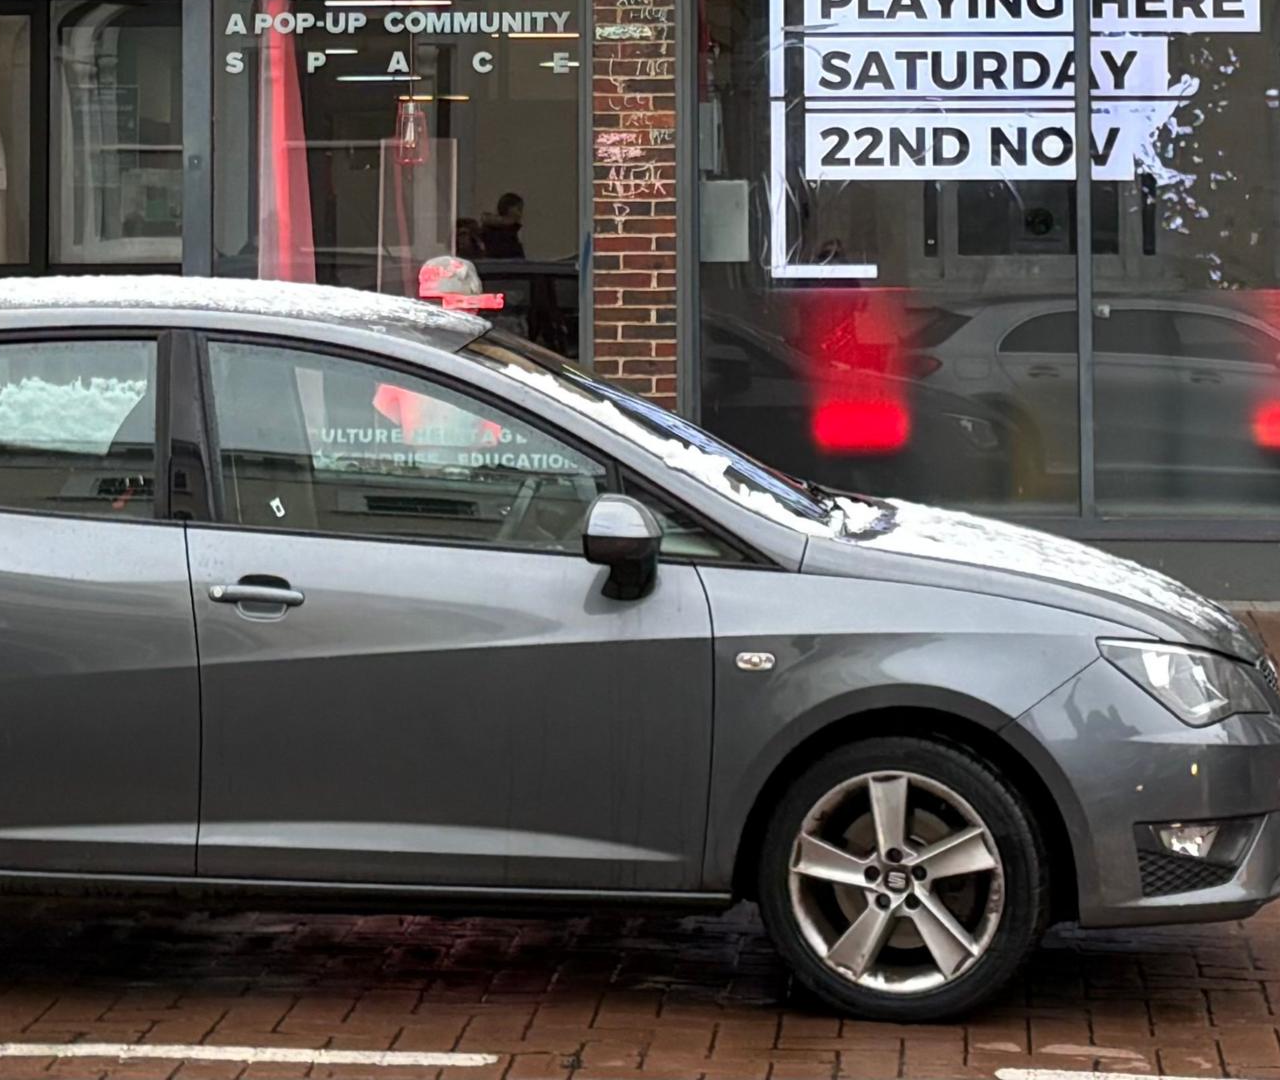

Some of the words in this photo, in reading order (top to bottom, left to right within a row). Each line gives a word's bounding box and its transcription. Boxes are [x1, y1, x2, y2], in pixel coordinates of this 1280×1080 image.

[225, 13, 247, 35] A
[254, 12, 368, 35] POP-UP
[384, 10, 571, 34] COMMUNITY
[820, 50, 1138, 91] SATURDAY
[820, 126, 970, 168] 22ND
[991, 126, 1122, 168] NOV
